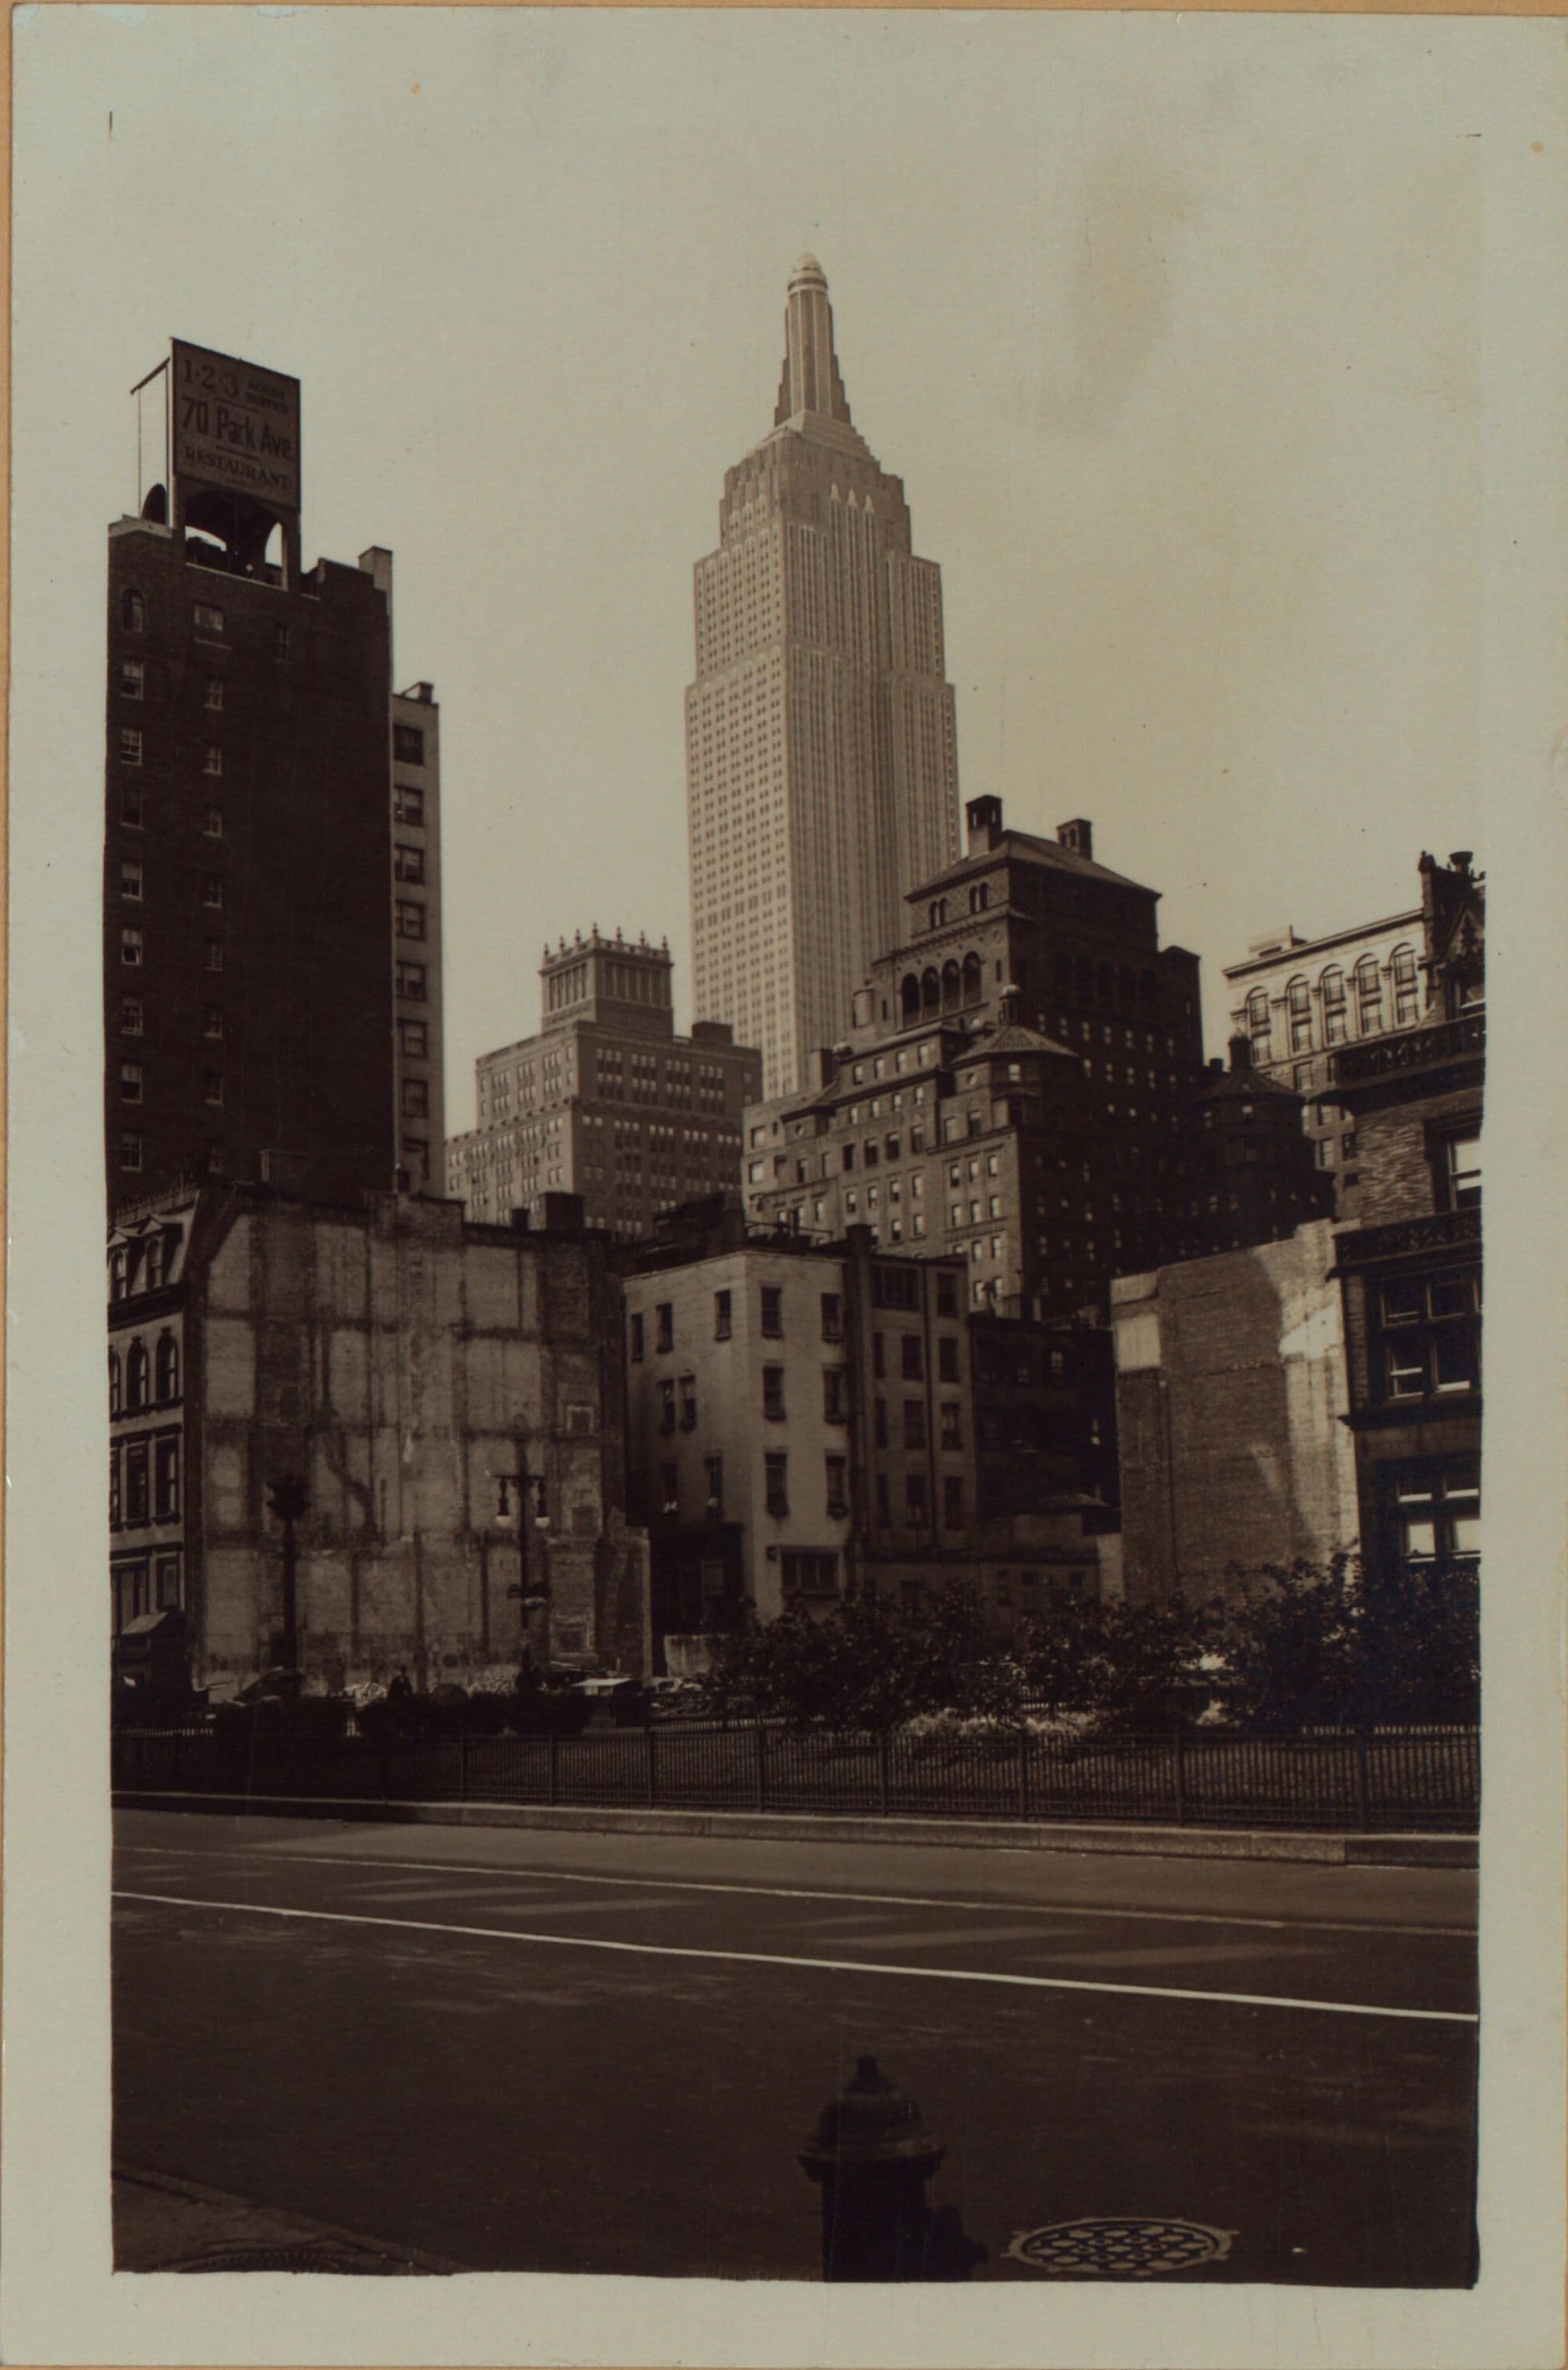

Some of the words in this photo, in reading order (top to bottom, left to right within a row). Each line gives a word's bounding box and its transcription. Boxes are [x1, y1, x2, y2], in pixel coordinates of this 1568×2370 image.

[182, 395, 209, 434] 70
[216, 406, 257, 450] Park
[260, 422, 293, 463] Ave
[185, 446, 289, 489] RESTAURANT
